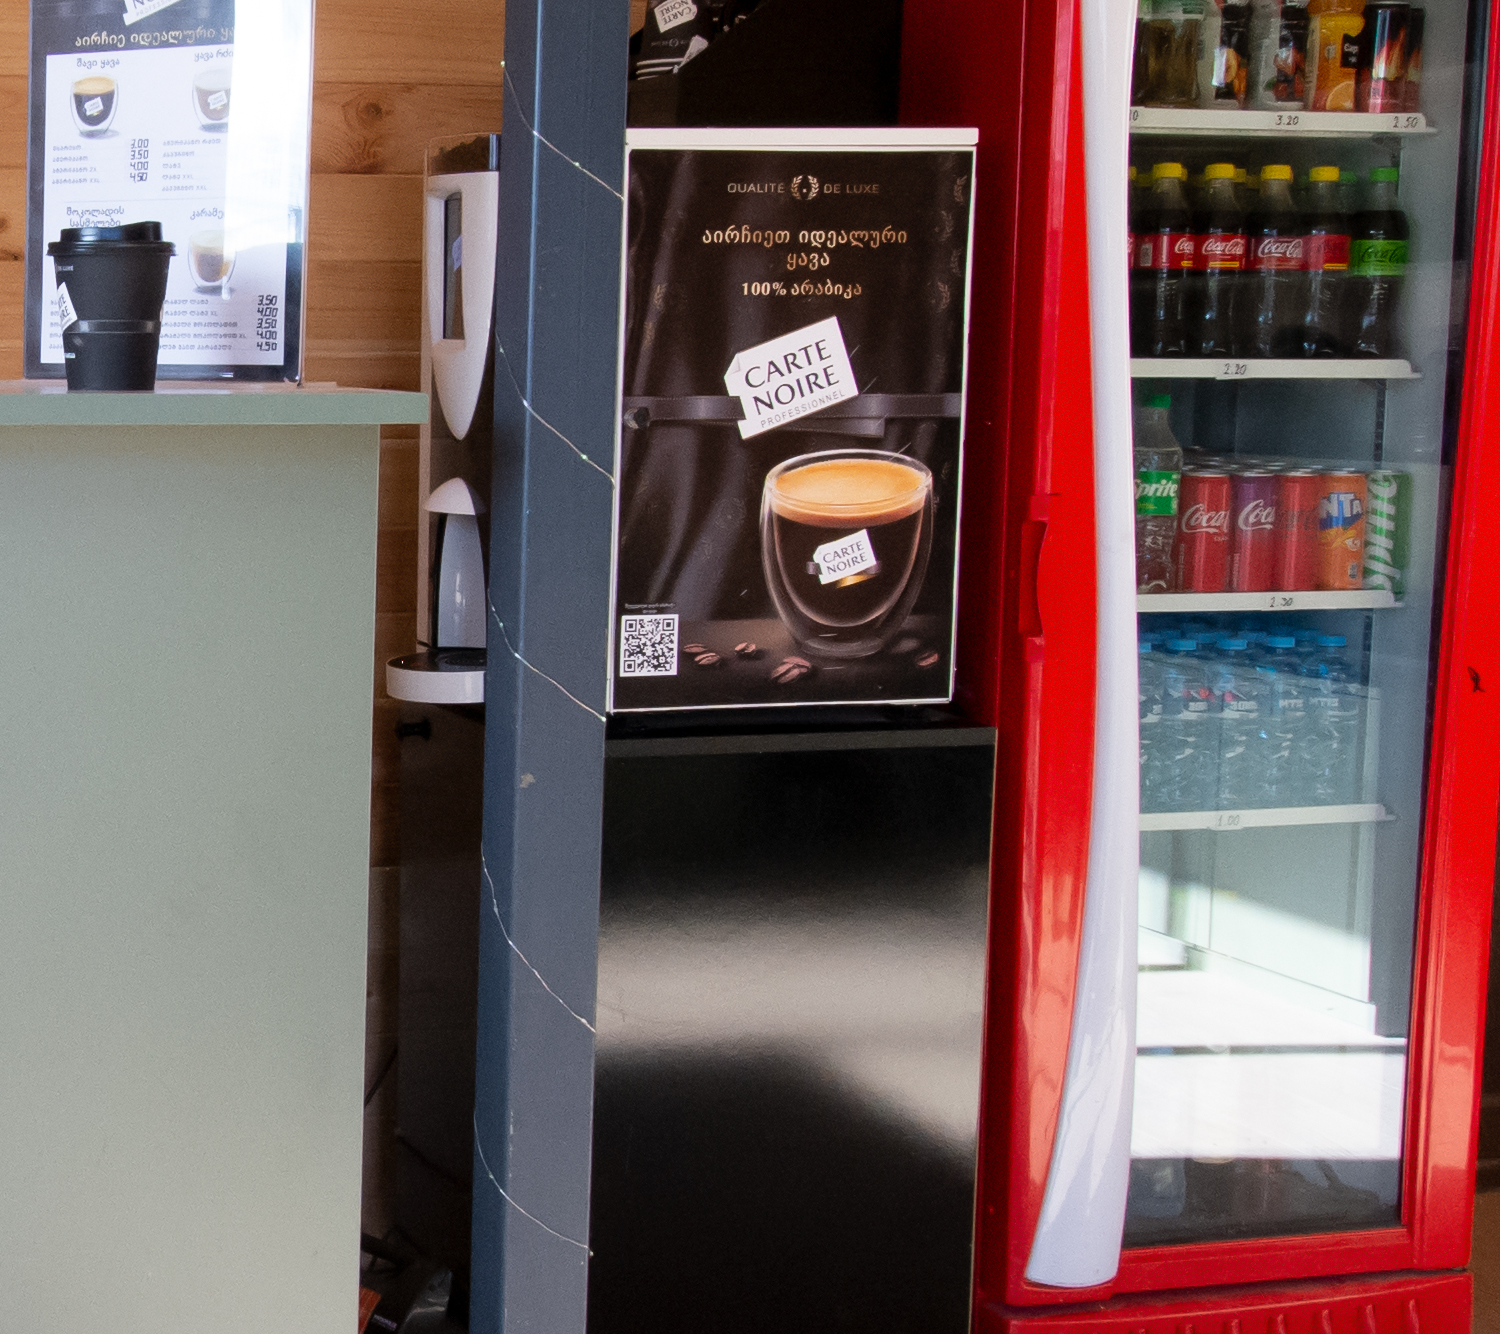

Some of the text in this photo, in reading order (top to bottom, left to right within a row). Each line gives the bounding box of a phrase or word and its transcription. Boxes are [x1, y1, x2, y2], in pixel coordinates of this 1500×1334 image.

[75, 31, 126, 48] აირჩიე
[130, 25, 216, 46] იდეალური
[823, 183, 841, 194] DE
[846, 183, 880, 194] LUXE
[702, 225, 908, 248] აირჩიეთ იდეალური
[786, 252, 830, 270] ყავა
[741, 278, 862, 299] 100% არაბიკა
[744, 338, 832, 389] CARTE
[752, 364, 840, 416] NOIRE
[760, 390, 846, 429] PROFESSIONNEL
[822, 540, 865, 564] CARTE
[826, 551, 868, 575] NOIRE
